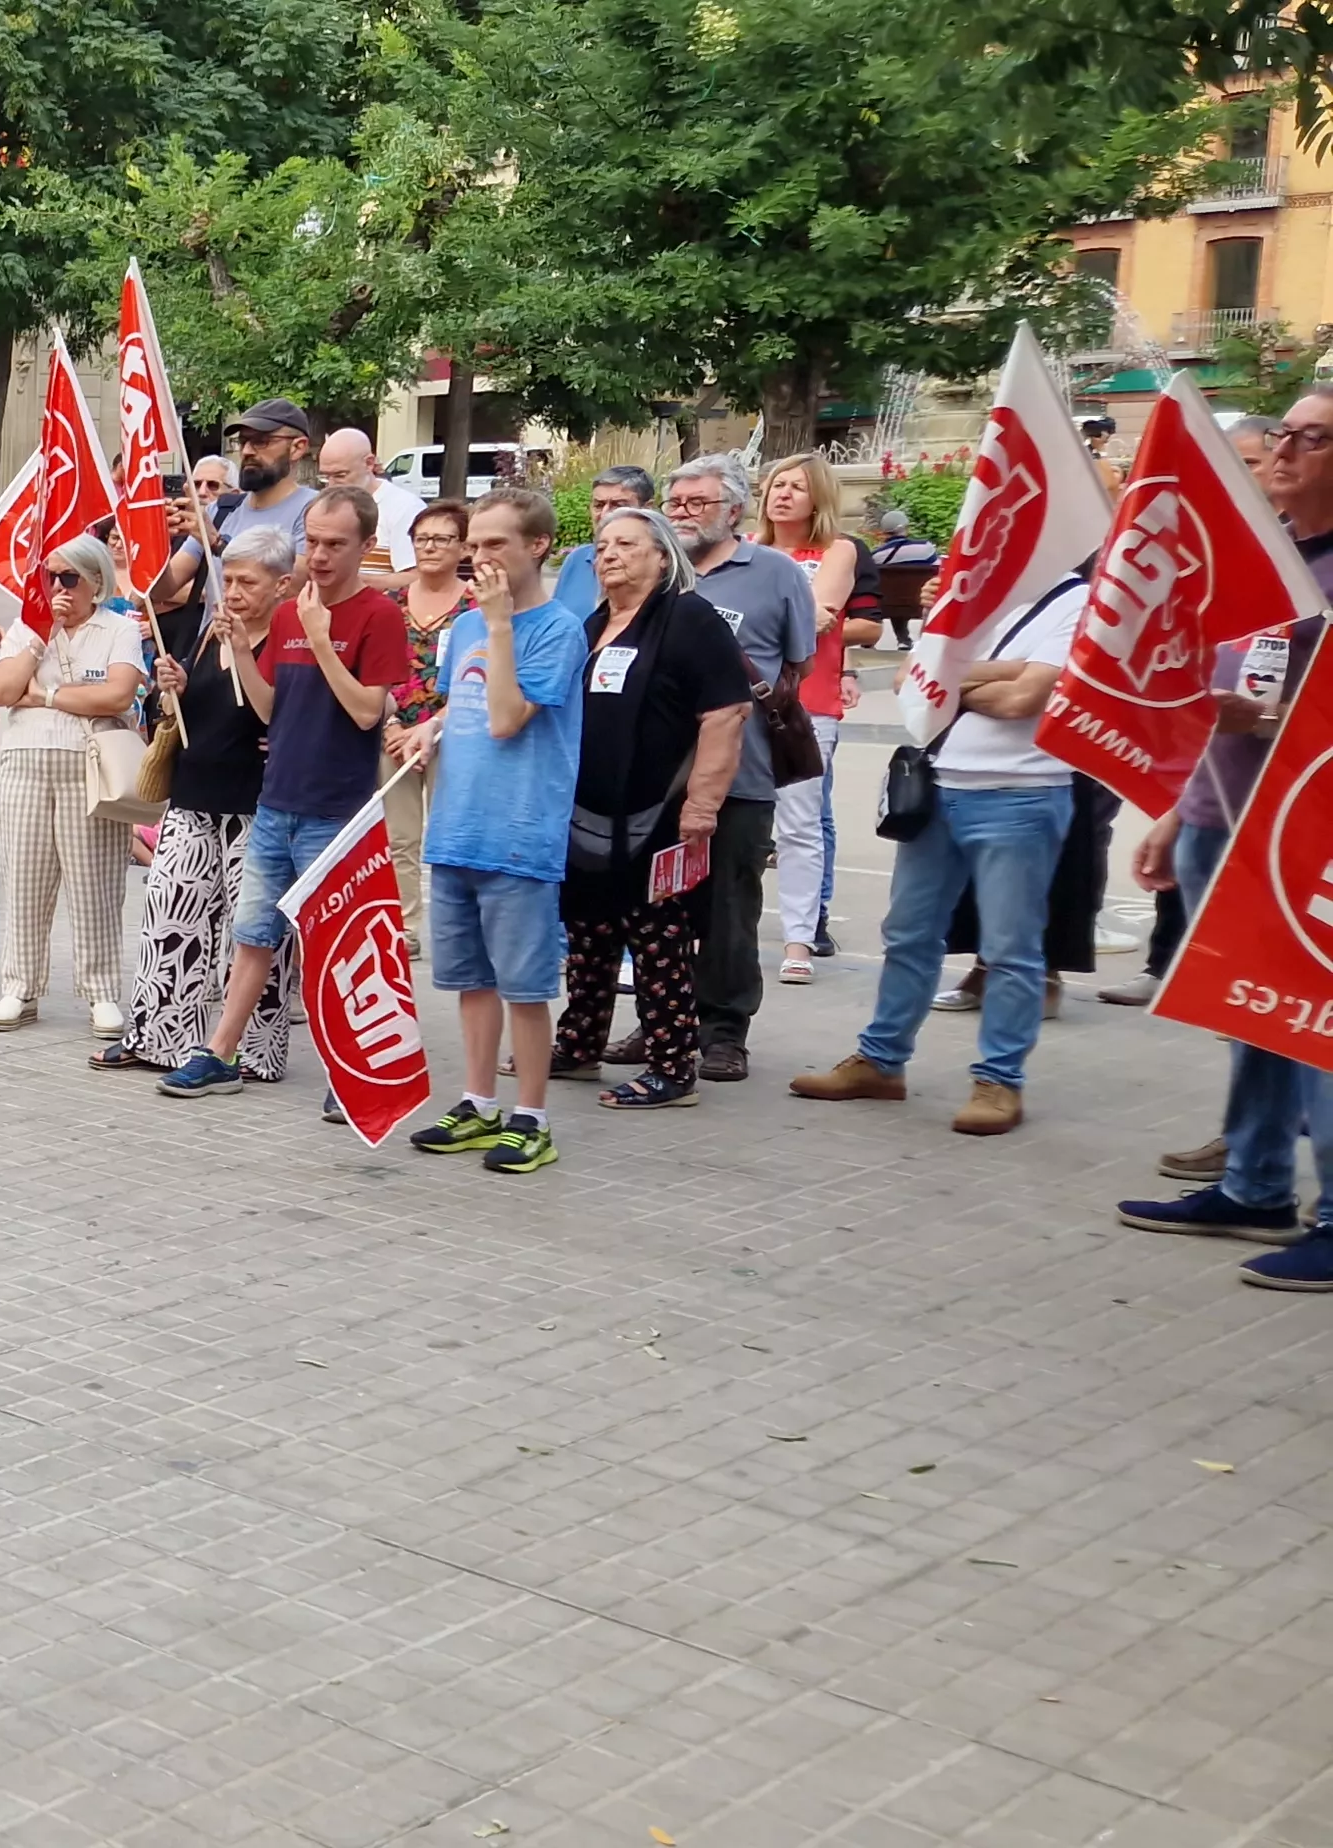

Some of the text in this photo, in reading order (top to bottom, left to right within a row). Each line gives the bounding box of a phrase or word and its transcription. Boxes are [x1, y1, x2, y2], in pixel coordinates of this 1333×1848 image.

[1257, 639, 1287, 651] STOP
[606, 649, 633, 657] STOP
[85, 669, 105, 678] STOP
[331, 936, 424, 1070] UGT
